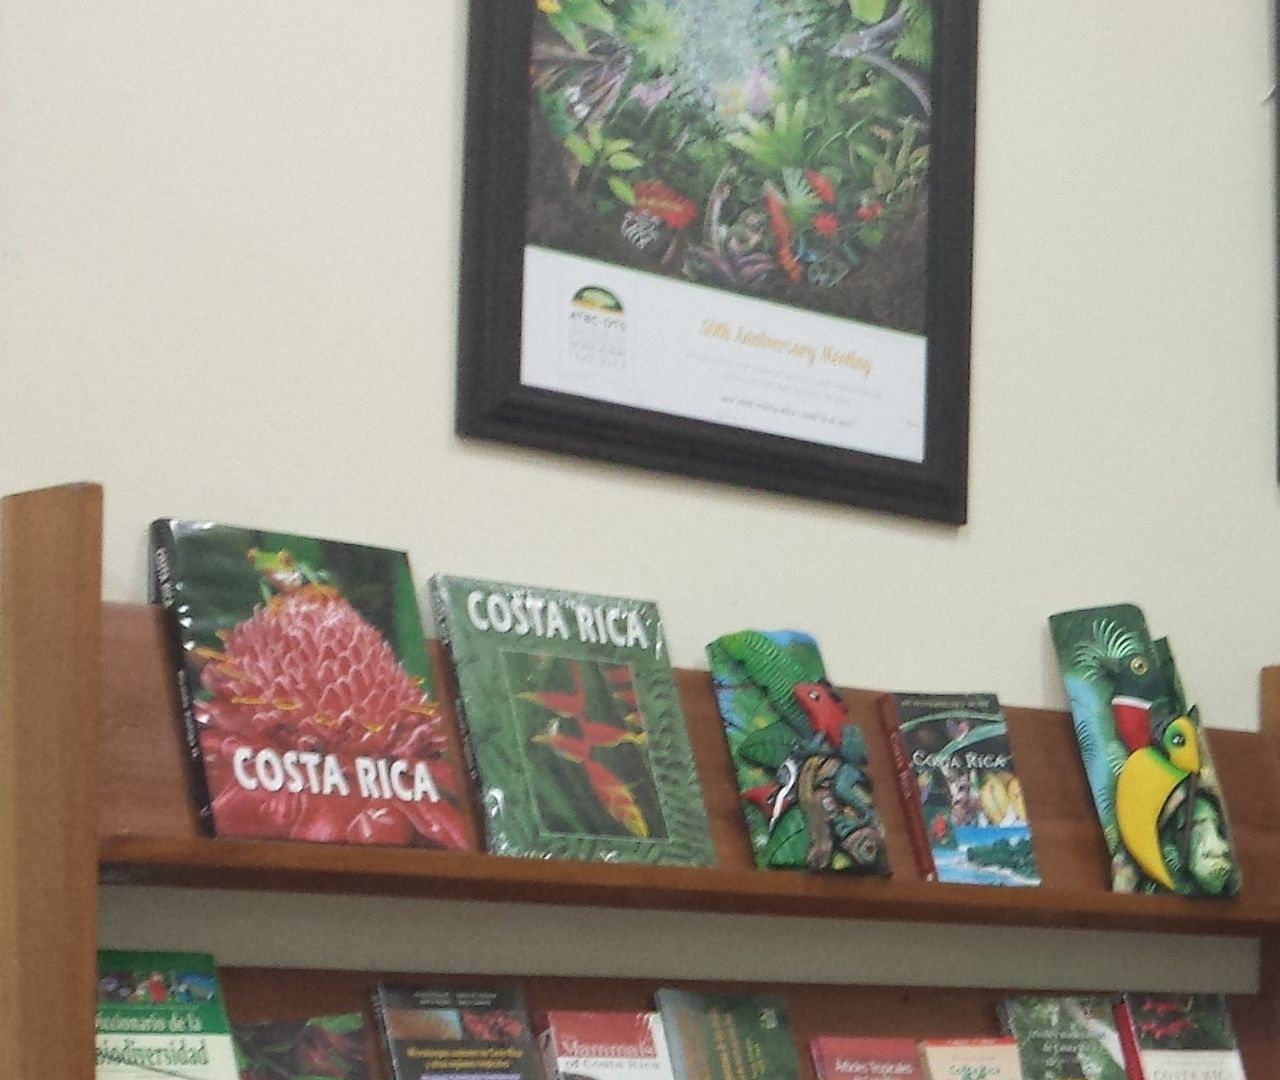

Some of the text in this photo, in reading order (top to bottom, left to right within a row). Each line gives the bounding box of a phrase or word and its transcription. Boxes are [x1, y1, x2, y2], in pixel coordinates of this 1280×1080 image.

[468, 590, 649, 650] COSTA RICA
[233, 746, 441, 804] COSTA RICA
